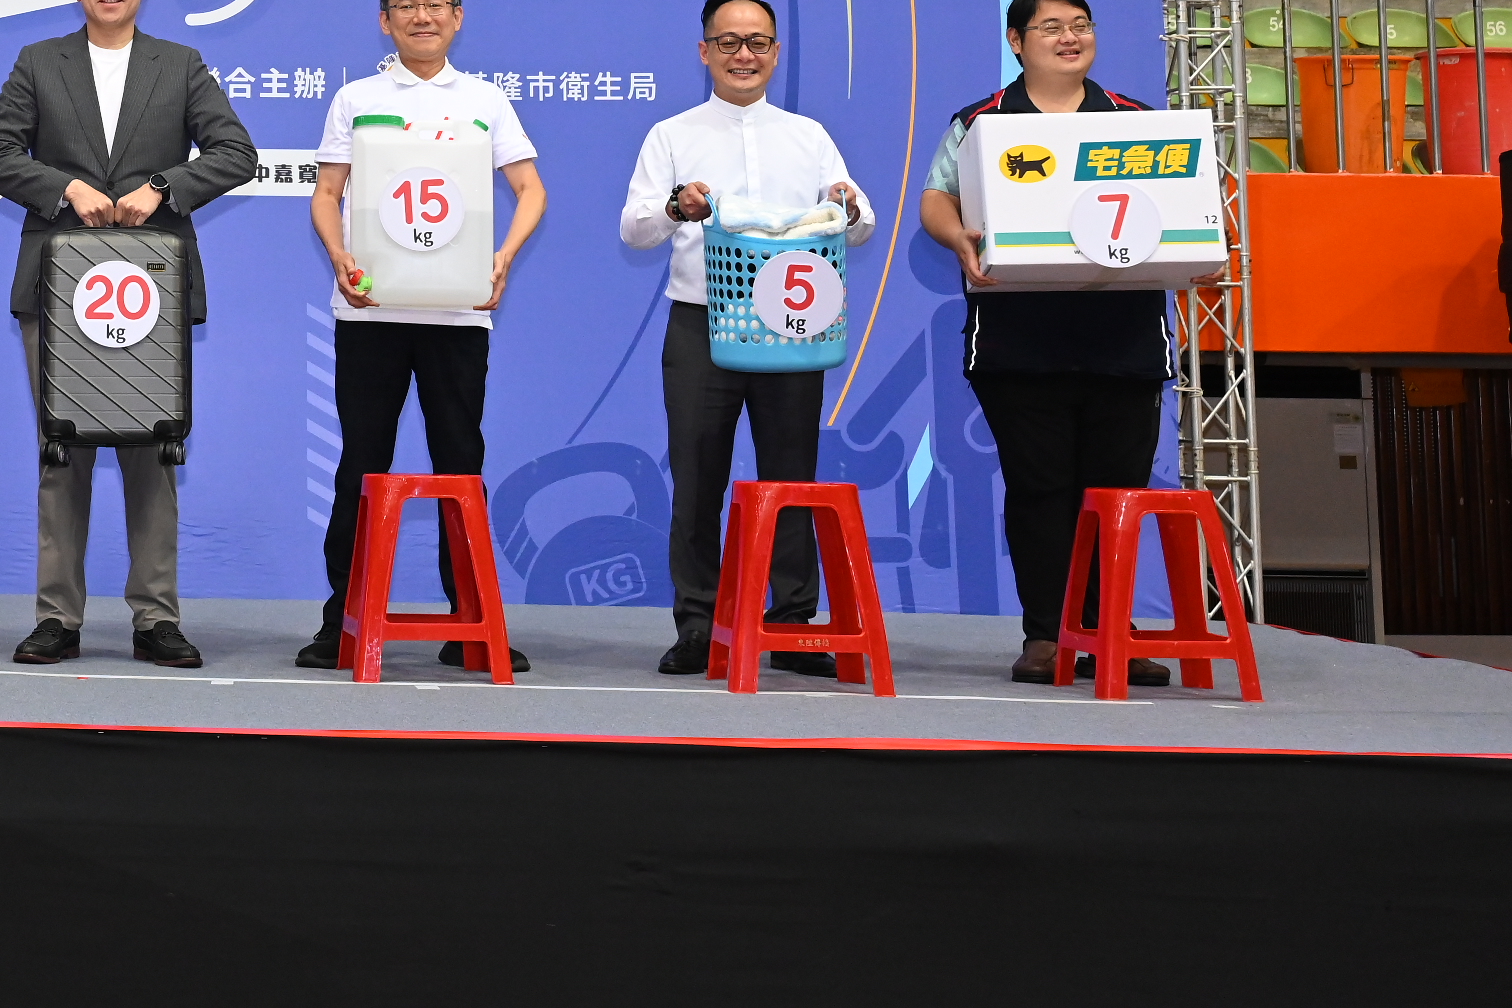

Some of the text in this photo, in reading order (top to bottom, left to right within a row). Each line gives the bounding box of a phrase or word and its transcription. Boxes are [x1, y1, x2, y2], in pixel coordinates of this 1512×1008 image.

[1487, 21, 1506, 36] 56
[1087, 143, 1191, 176] 宅急便
[392, 178, 449, 224] 15
[1097, 193, 1130, 240] 7
[1204, 215, 1218, 224] 12
[413, 228, 434, 246] kg
[1107, 244, 1131, 263] kg
[84, 274, 151, 320] 20
[783, 264, 815, 311] 5
[106, 323, 126, 344] kg
[785, 313, 806, 334] kg
[580, 563, 633, 602] KG
